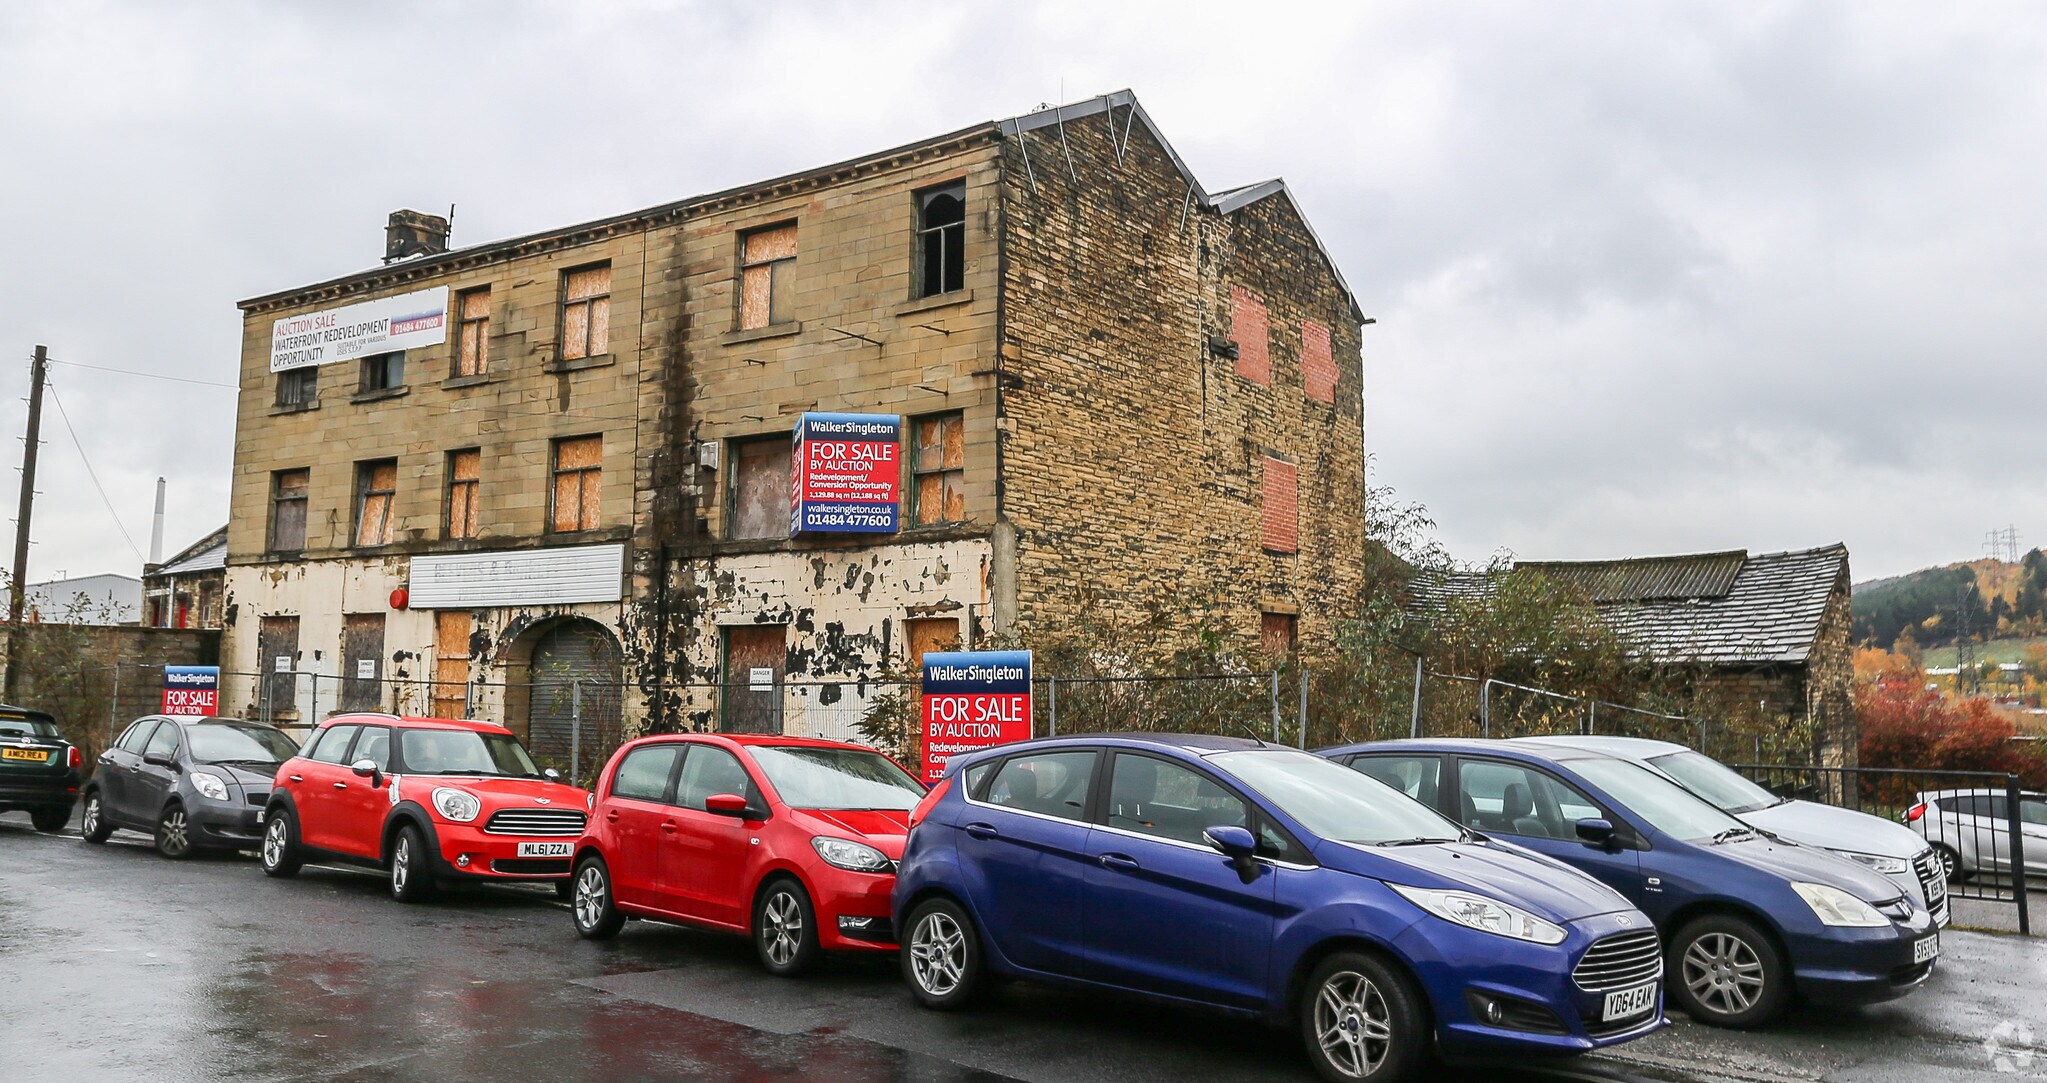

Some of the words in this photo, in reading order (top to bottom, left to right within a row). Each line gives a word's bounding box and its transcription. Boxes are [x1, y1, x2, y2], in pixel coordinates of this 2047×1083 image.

[276, 319, 312, 337] AUCTION
[315, 314, 336, 329] SALE
[275, 332, 322, 351] WATERFRONT
[324, 318, 388, 343] REDEVELOPMENT
[273, 346, 324, 367] OPPORTUNITY
[811, 443, 846, 459] FOR
[851, 444, 892, 460] SALE
[810, 461, 823, 469] BY
[825, 461, 873, 471] AUCTION
[809, 473, 868, 482] Redevelopment/
[849, 482, 892, 491] Opportunity
[808, 504, 892, 515] walkersingleton.co.uk
[807, 514, 844, 525] 01484
[846, 515, 891, 526] 477600
[167, 691, 187, 705] FOR
[189, 691, 214, 706] SALE
[166, 706, 174, 714] BY
[174, 706, 202, 715] AUCTION
[931, 698, 969, 721] FOR
[975, 697, 1022, 721] SALE
[930, 723, 944, 737] BY
[946, 723, 1000, 738] AUCTION
[524, 844, 547, 855] ML61
[550, 844, 568, 855] ZZA
[1610, 991, 1634, 1015] YD64
[1636, 985, 1653, 1009] EAK
